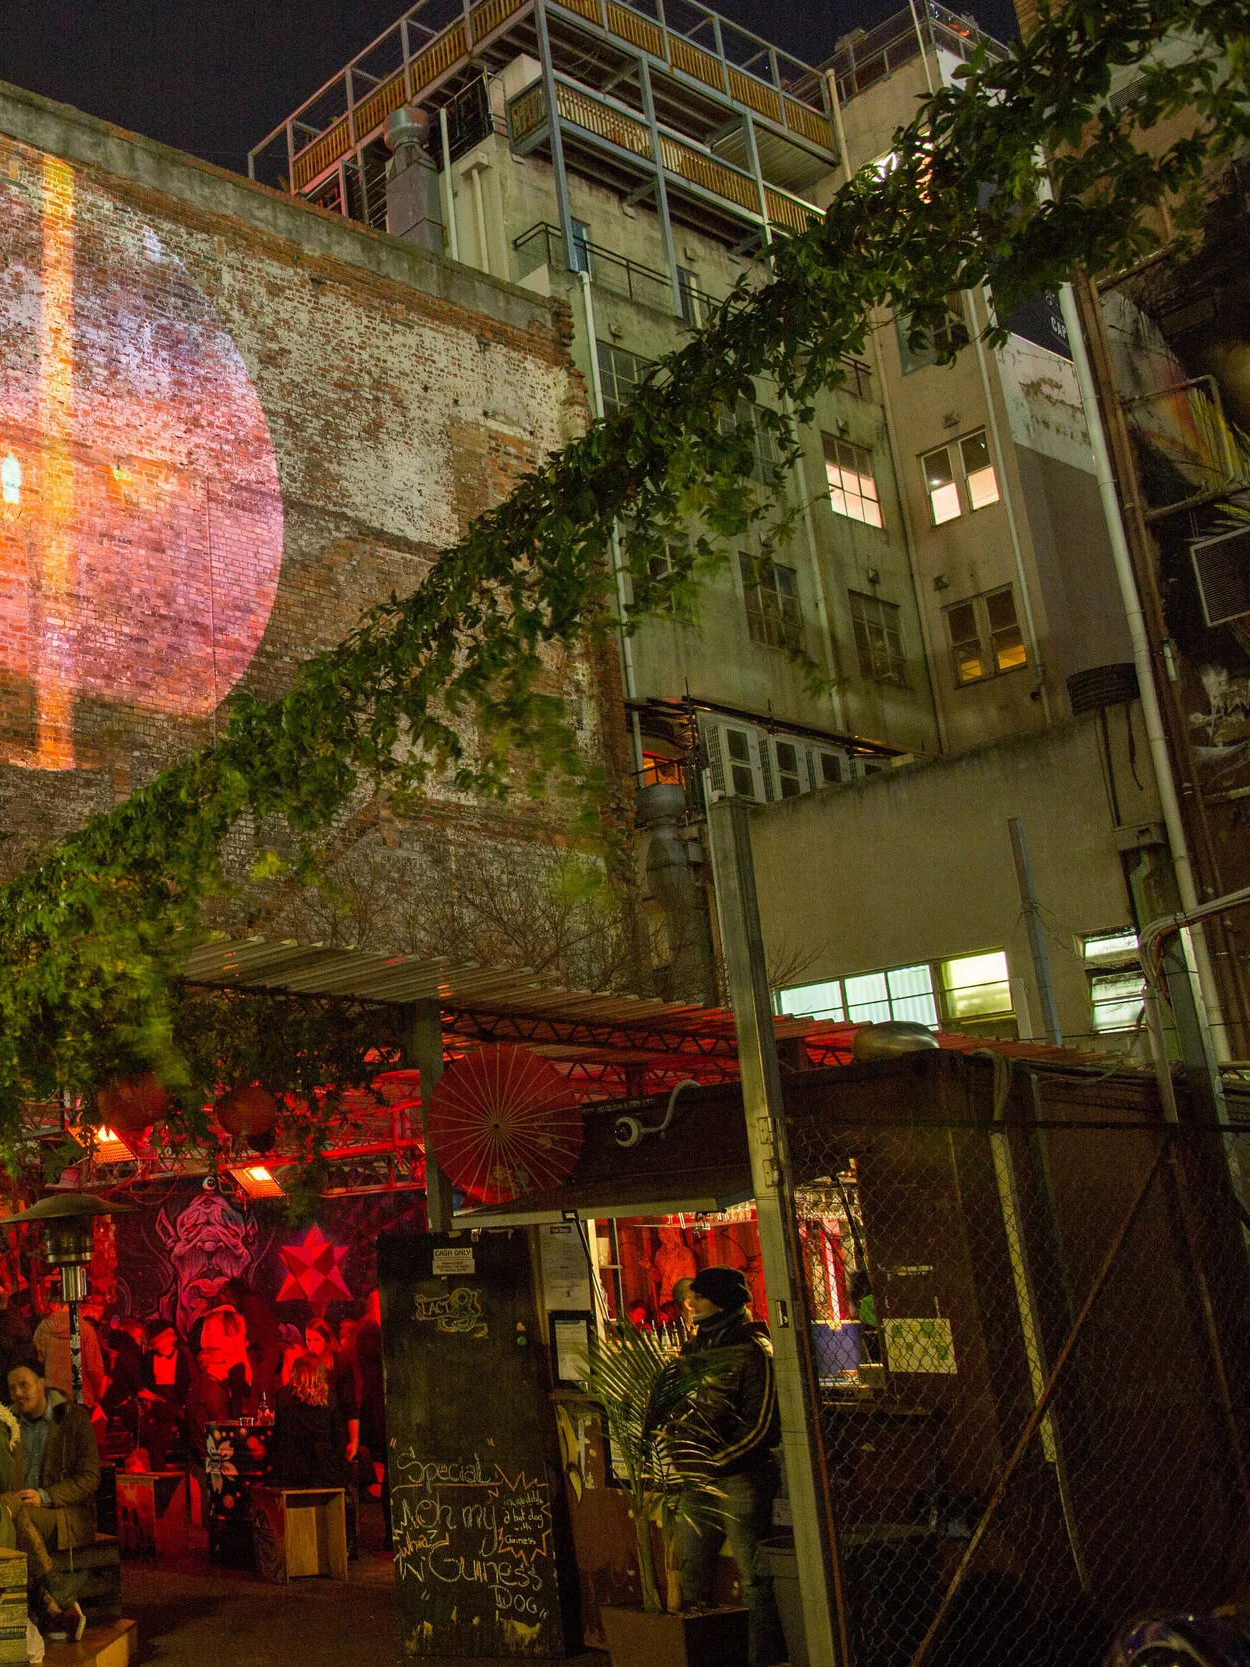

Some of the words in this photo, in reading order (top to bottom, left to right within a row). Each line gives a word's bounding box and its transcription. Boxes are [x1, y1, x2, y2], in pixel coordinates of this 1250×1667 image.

[462, 1504, 498, 1557] my
[512, 1508, 526, 1522] hot
[527, 1508, 544, 1528] dog
